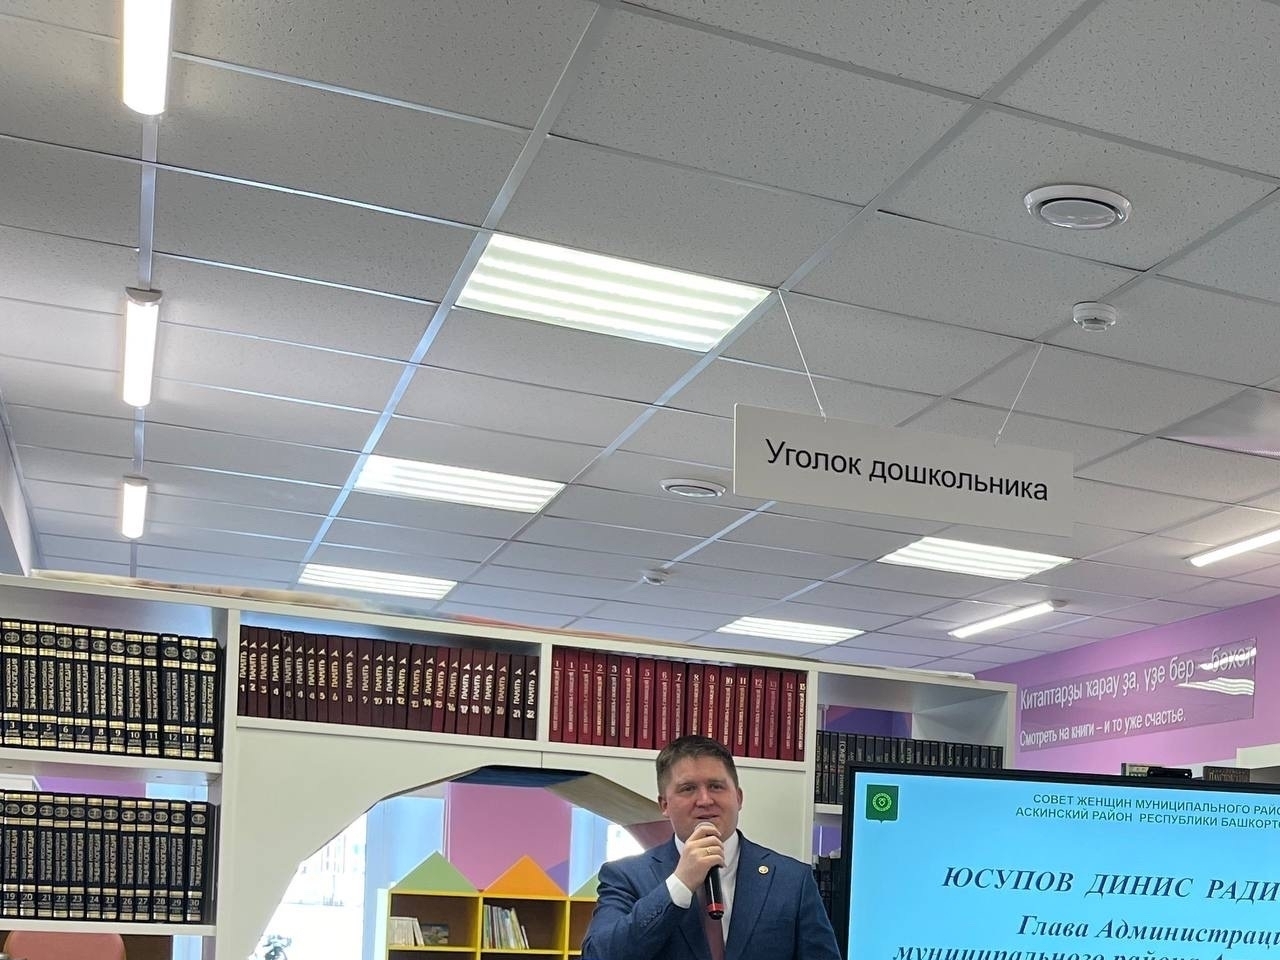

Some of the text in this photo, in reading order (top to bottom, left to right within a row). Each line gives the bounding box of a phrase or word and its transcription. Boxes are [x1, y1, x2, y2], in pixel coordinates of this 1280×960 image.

[765, 438, 1048, 501] Уголок дошкольника
[1170, 656, 1194, 684] бер
[1020, 730, 1058, 748] Смотреть
[1059, 728, 1069, 740] на
[1072, 723, 1095, 738] книги
[1104, 721, 1110, 733] и
[1112, 718, 1122, 732] то
[1124, 714, 1143, 735] уже
[1146, 708, 1186, 728] счастье.
[1015, 806, 1089, 820] АСКИНСКИЙ
[1092, 809, 1133, 822] РАЙОН
[1140, 813, 1218, 827] РЕСПУБЛИКИ
[1033, 794, 1073, 805] СОВЕТ
[1077, 796, 1132, 809] ЖЕНЩИН
[1135, 798, 1250, 815] МУНИЦИПАЛЬНОГО
[942, 866, 1074, 893] ЮСУПОВ
[1084, 872, 1194, 899] ДИНИС
[1016, 914, 1090, 939] Глава
